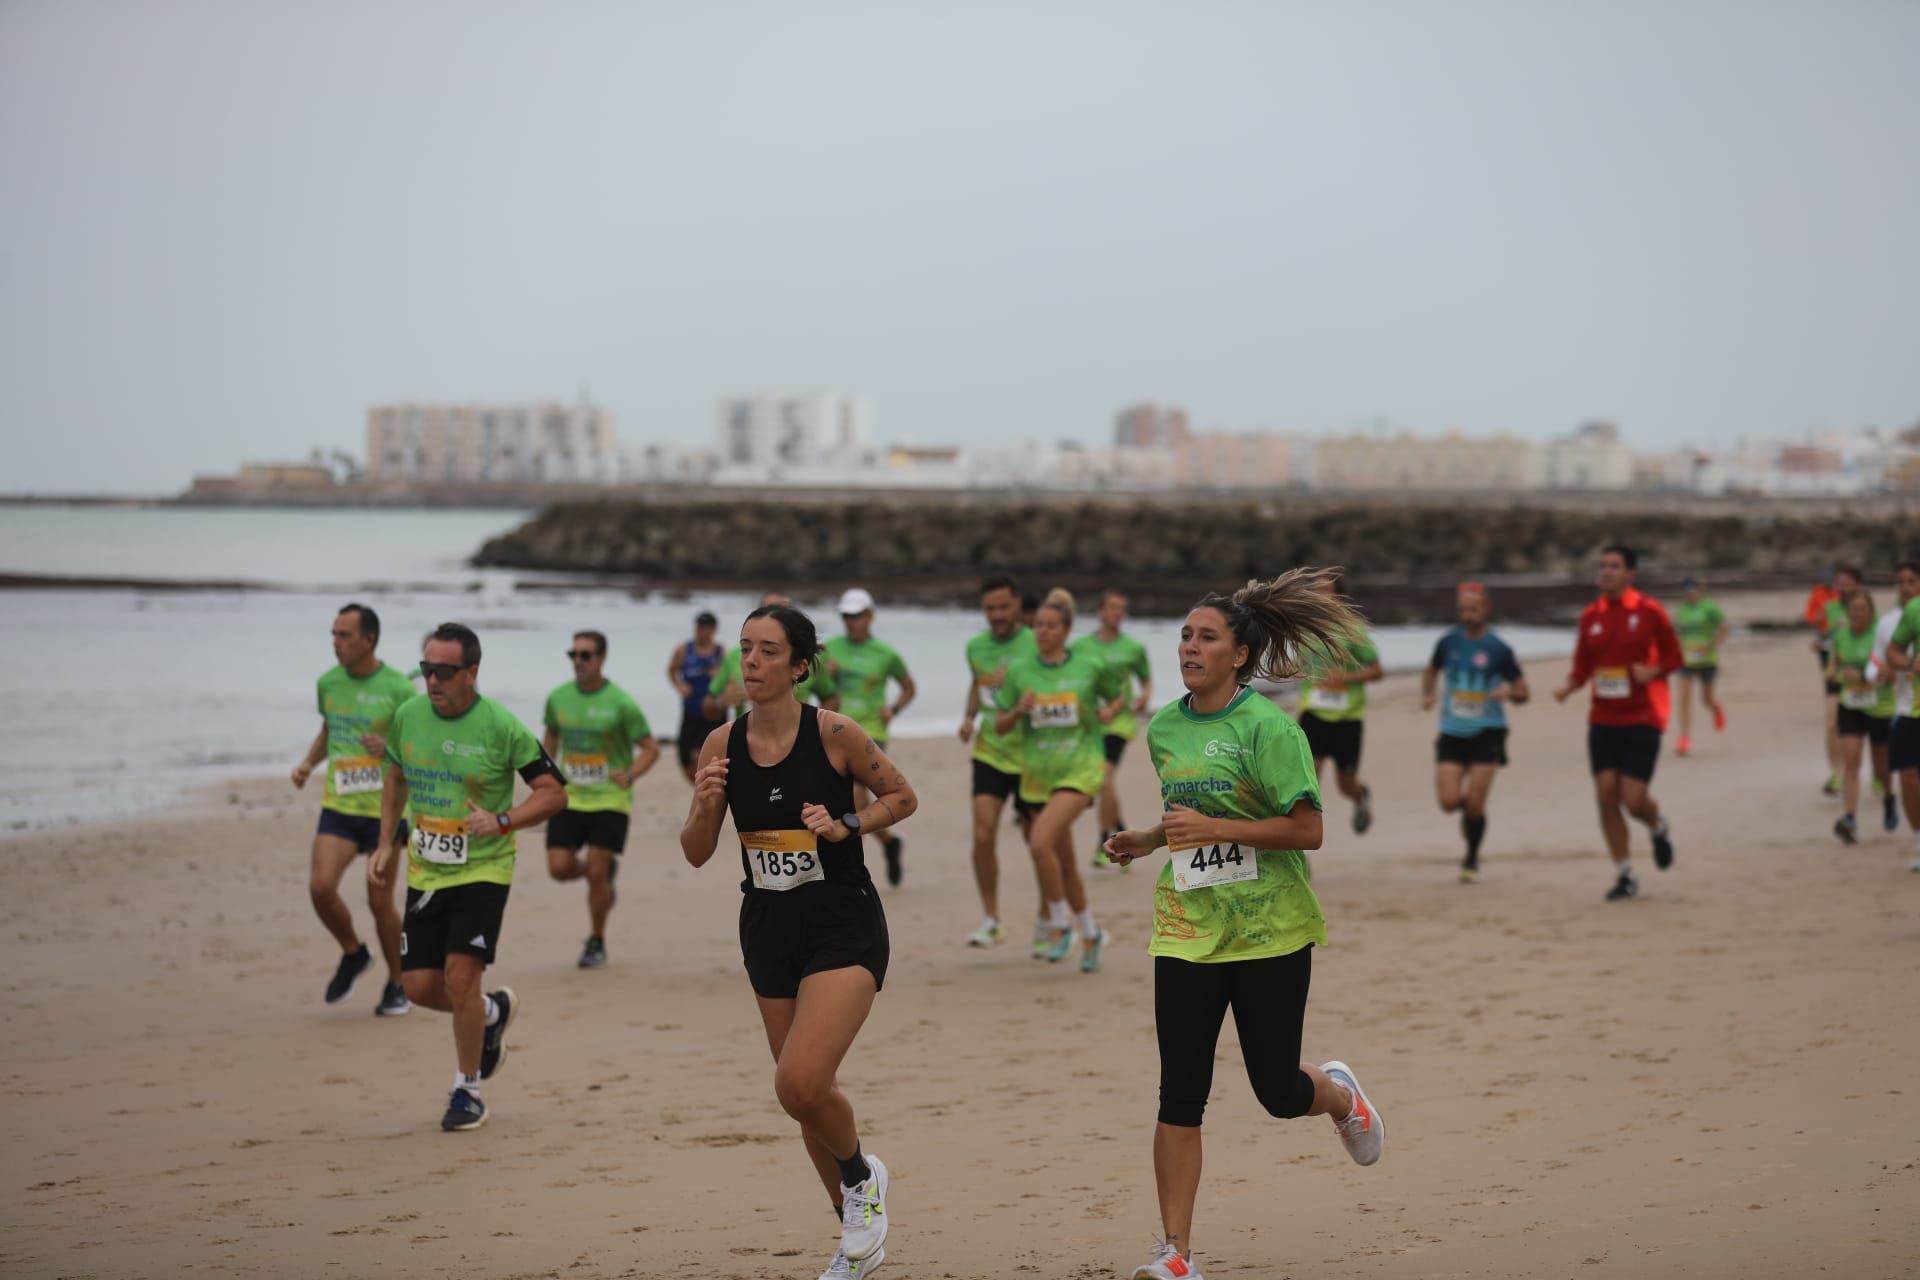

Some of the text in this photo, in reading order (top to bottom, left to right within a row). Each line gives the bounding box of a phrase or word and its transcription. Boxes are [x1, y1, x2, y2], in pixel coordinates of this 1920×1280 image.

[341, 766, 381, 785] 2600
[415, 767, 463, 784] marcha
[1174, 777, 1232, 793] marcha
[417, 830, 465, 853] 3759
[757, 850, 815, 876] 1853
[1190, 842, 1244, 872] 444
